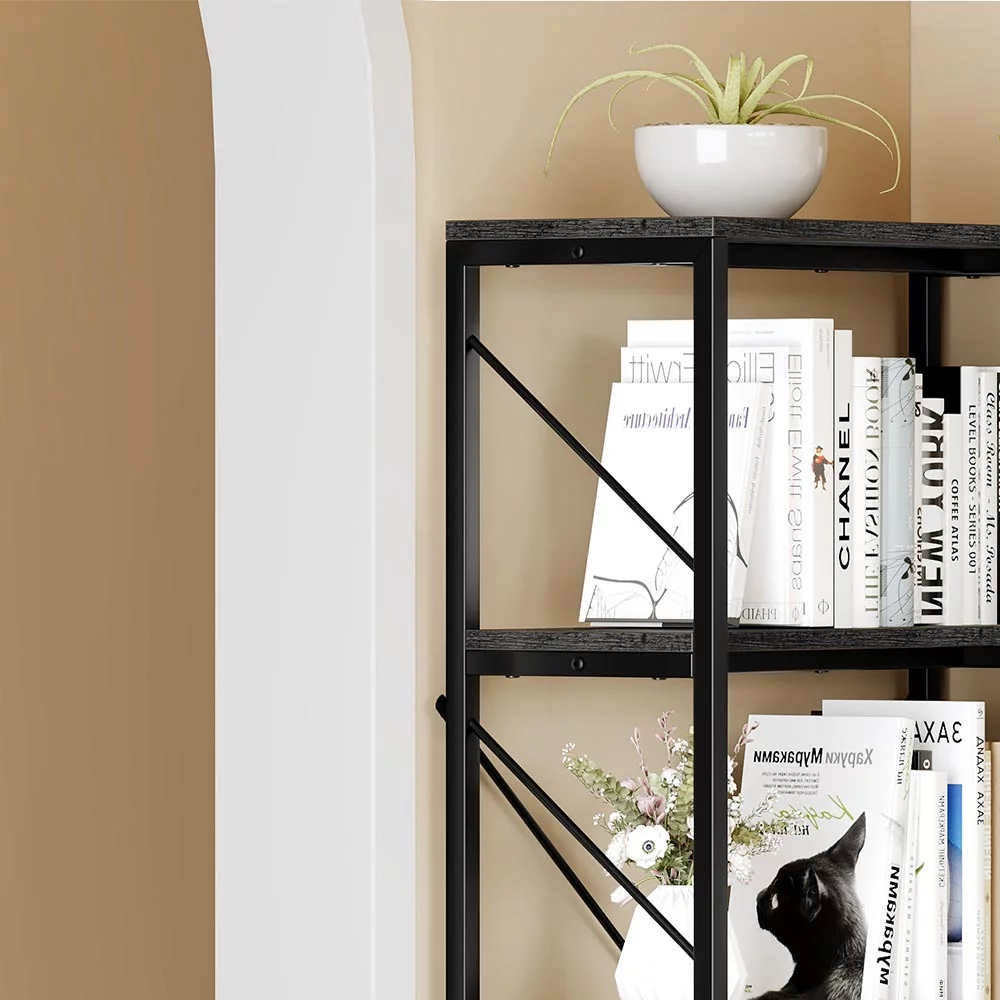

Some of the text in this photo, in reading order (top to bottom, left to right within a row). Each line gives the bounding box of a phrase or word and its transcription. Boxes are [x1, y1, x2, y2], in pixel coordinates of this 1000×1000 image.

[838, 402, 850, 570] CHANEL
[951, 478, 959, 562] COFFEE ATLAS
[968, 404, 976, 574] LEVEL BOOKS SERIES 001
